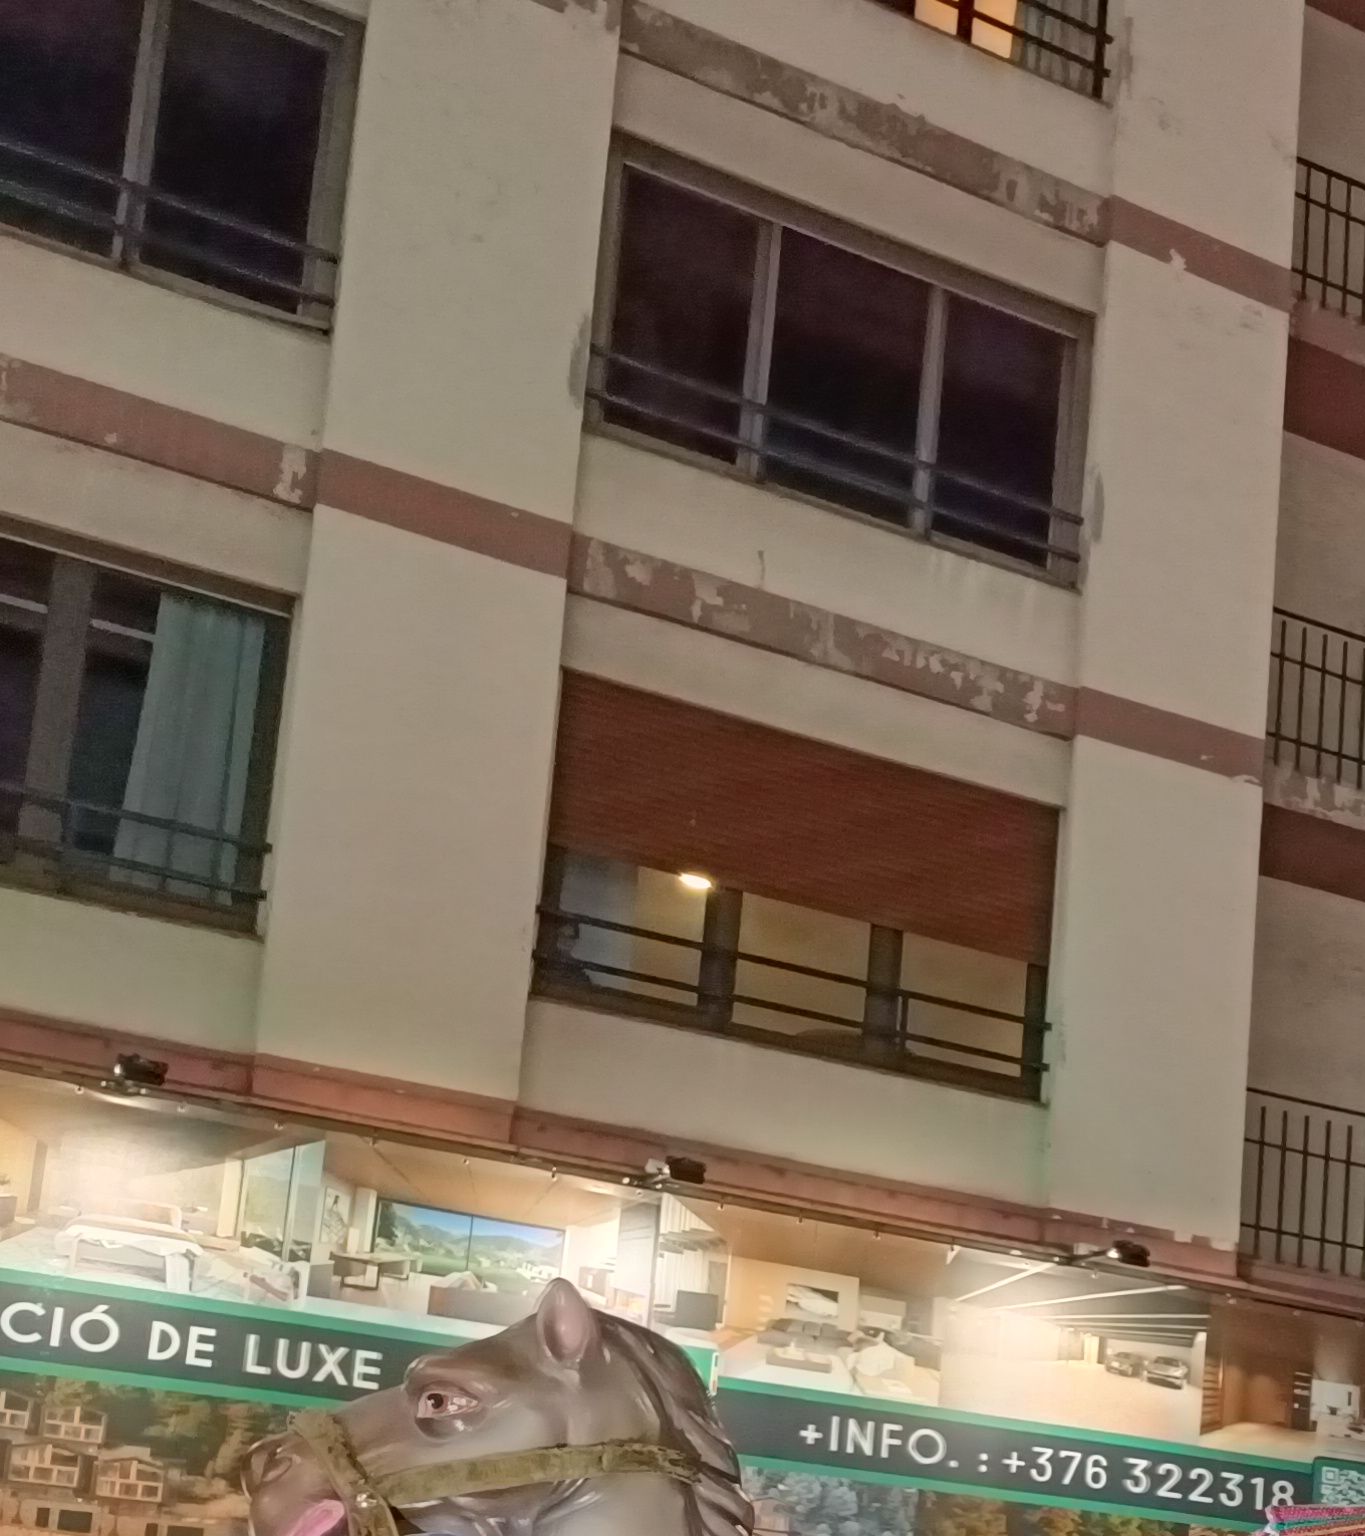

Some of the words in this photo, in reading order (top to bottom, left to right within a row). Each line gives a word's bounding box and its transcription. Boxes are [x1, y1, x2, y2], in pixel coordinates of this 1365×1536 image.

[148, 1320, 218, 1368] DE
[243, 1333, 383, 1391] LUXE
[799, 1415, 959, 1470] +INFO.
[1002, 1445, 1109, 1490] +376
[1125, 1457, 1295, 1509] 322318
